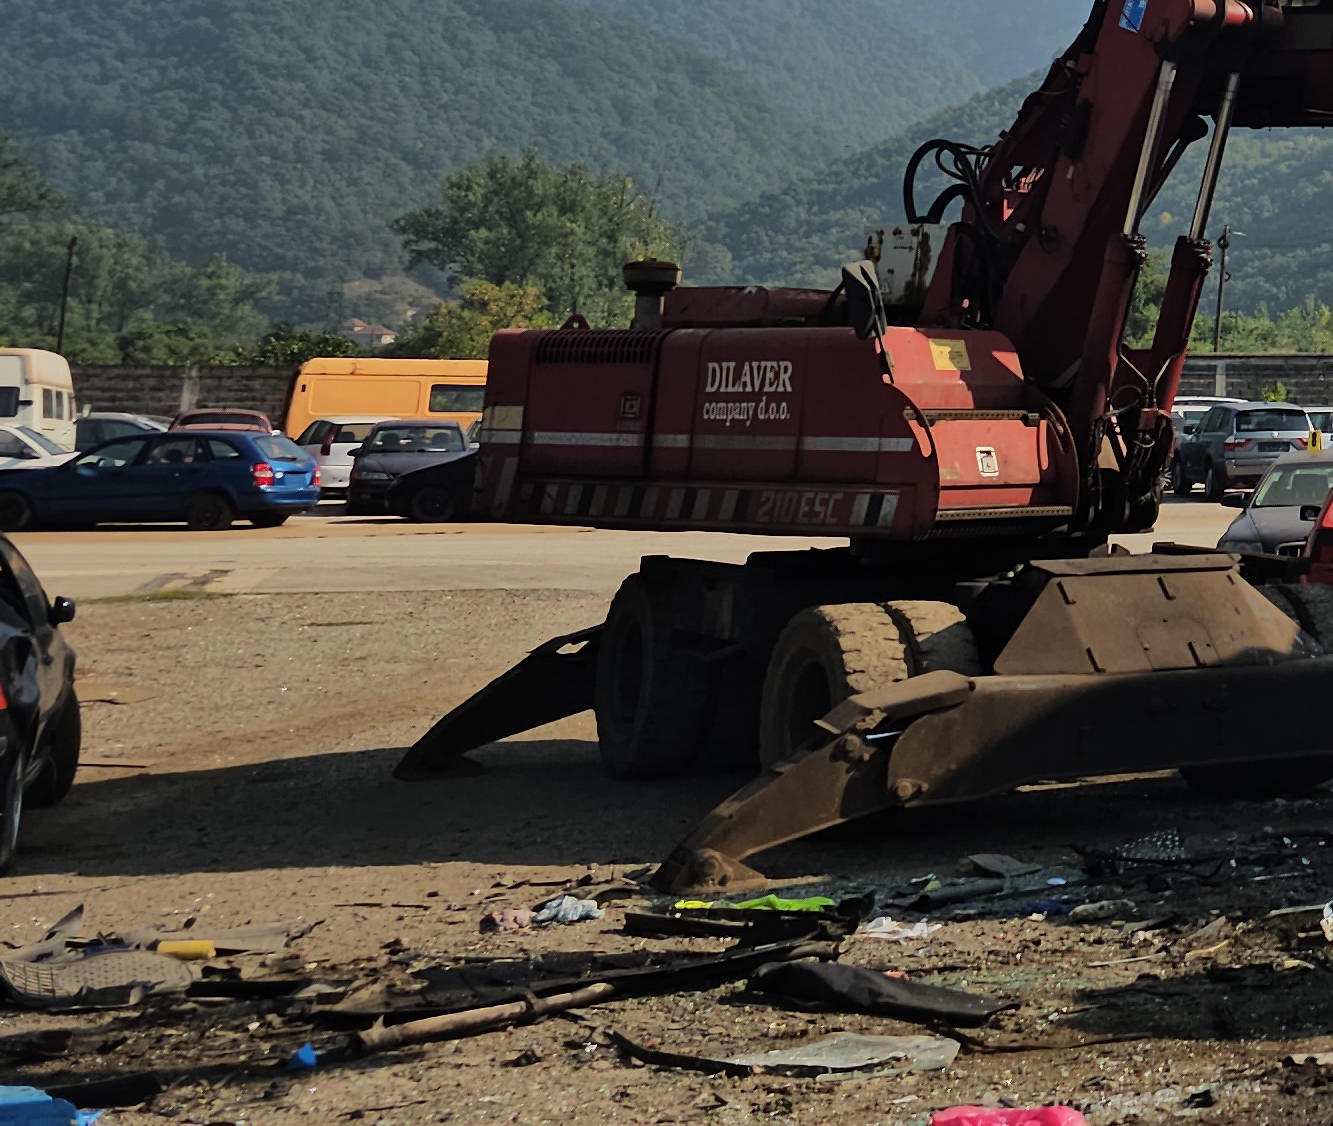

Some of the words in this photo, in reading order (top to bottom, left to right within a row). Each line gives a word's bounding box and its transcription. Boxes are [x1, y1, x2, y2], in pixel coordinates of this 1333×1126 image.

[704, 360, 793, 393] DILAVER
[703, 401, 756, 427] company
[757, 395, 791, 420] d.o.o.
